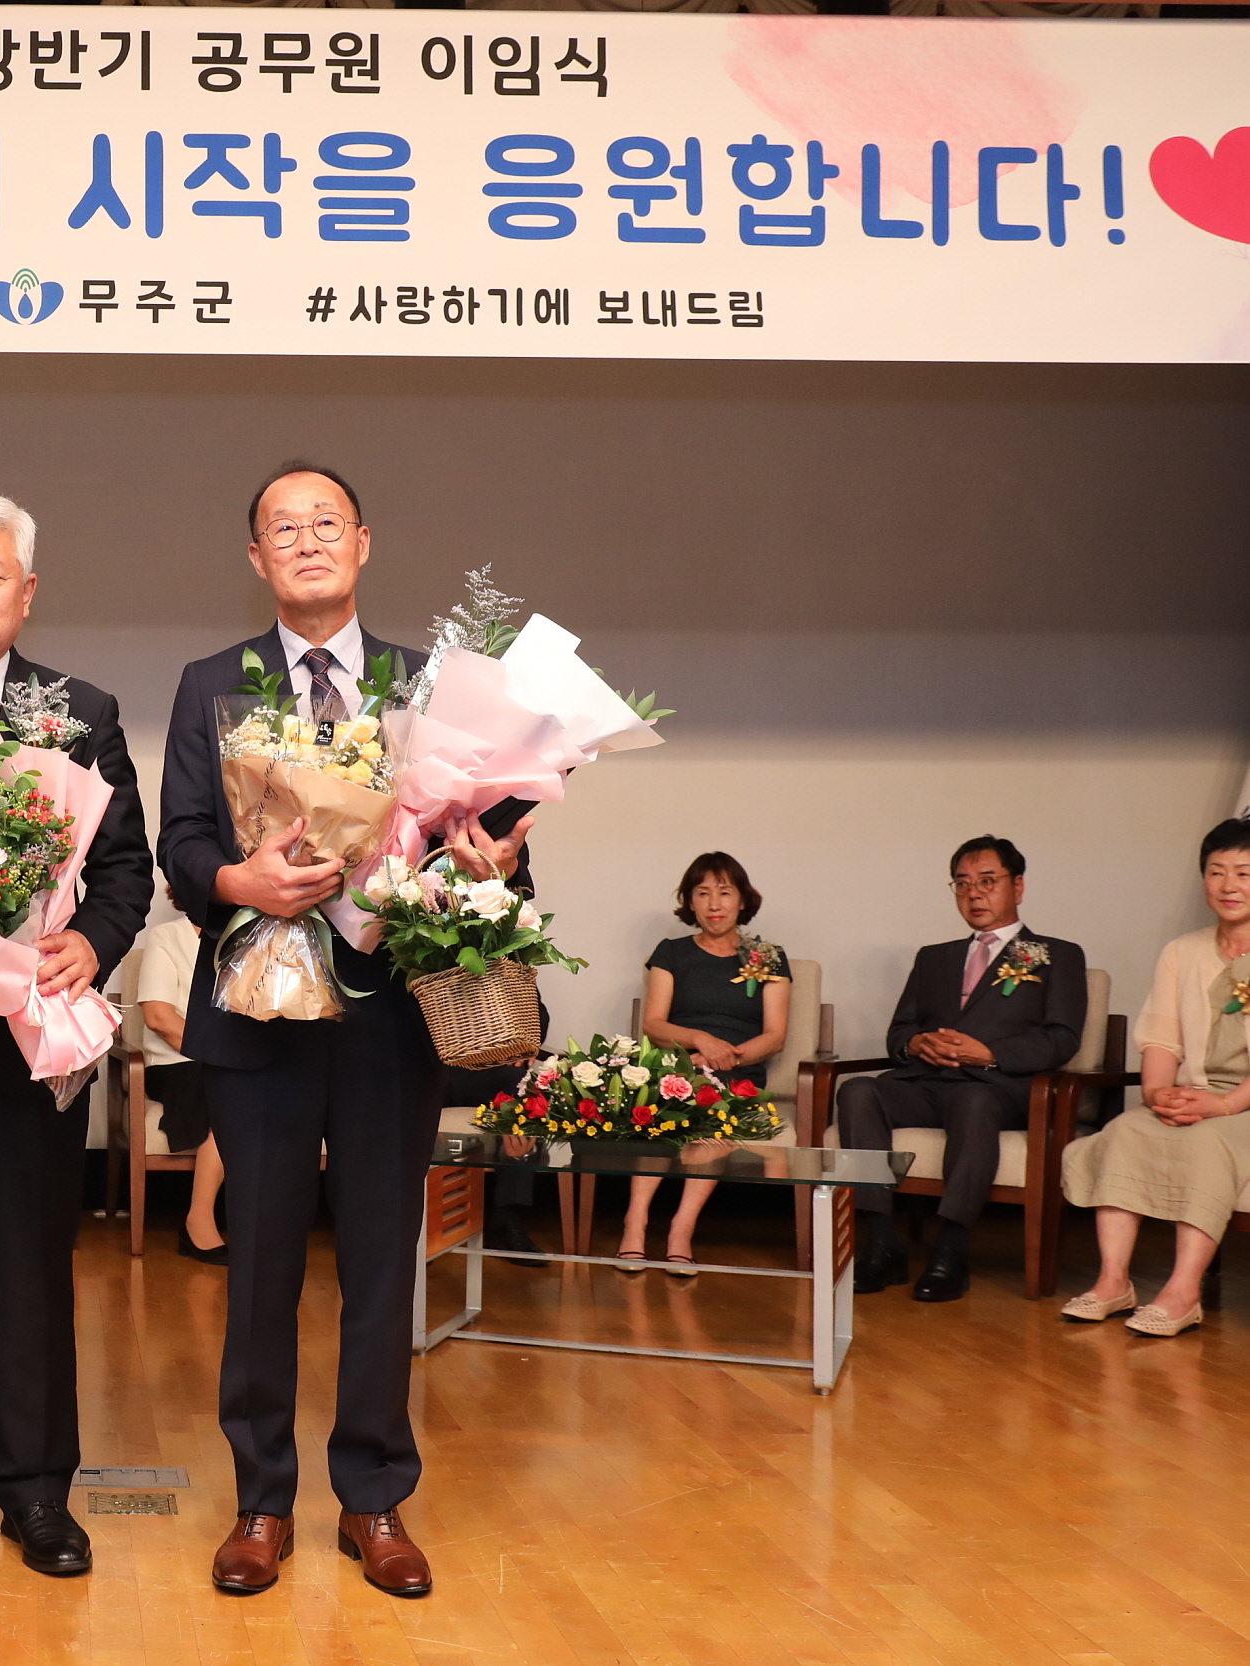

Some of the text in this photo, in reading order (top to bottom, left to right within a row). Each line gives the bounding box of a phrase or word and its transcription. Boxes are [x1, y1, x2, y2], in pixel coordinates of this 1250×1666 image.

[191, 31, 382, 94] 공무원
[421, 34, 609, 98] 이임식
[67, 130, 417, 242] 시작을
[481, 133, 1127, 247] 응원합니다!
[78, 279, 234, 324] 무주군
[305, 284, 765, 328] #사랑하기에 보내드림
